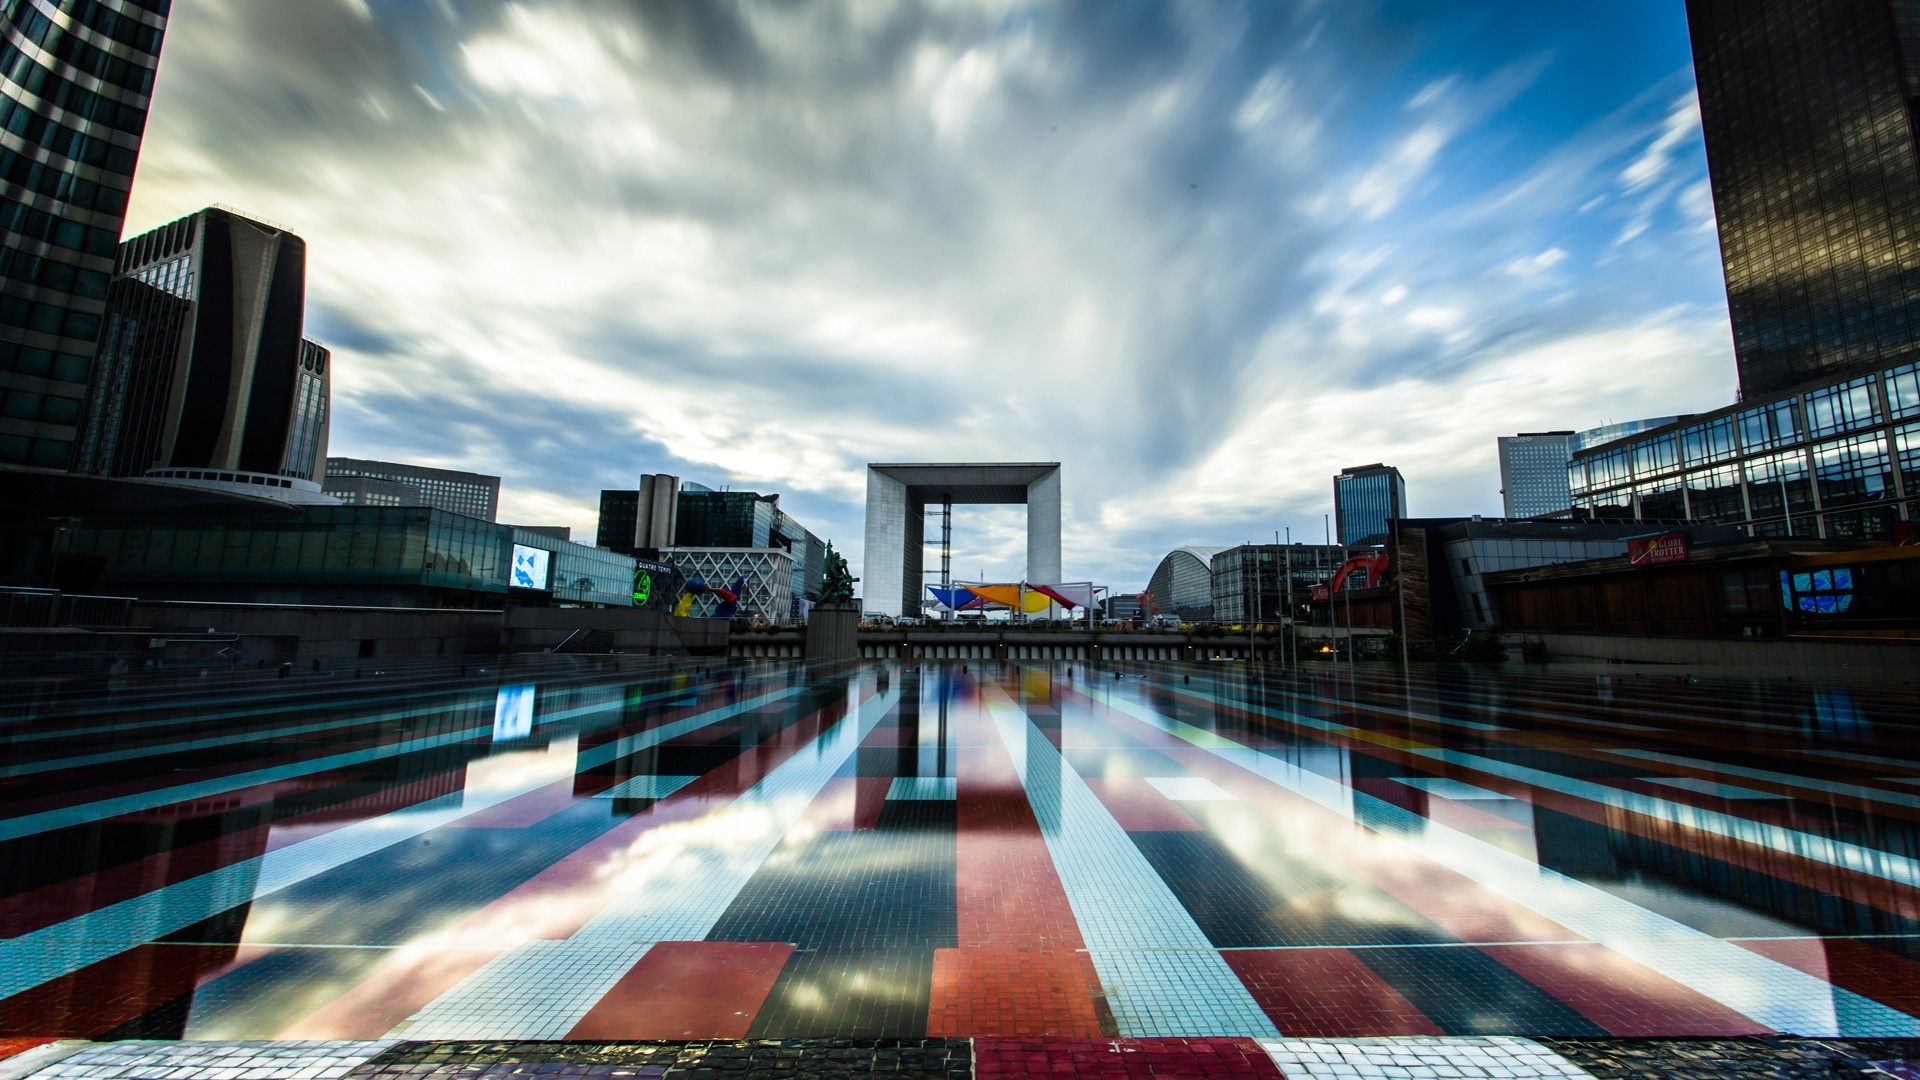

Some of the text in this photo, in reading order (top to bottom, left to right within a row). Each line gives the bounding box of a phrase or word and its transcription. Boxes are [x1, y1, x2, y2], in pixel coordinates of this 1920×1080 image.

[1659, 539, 1682, 549] GLOBE
[1651, 547, 1684, 557] TROTTER
[638, 562, 672, 574] QUATRE TEMPS
